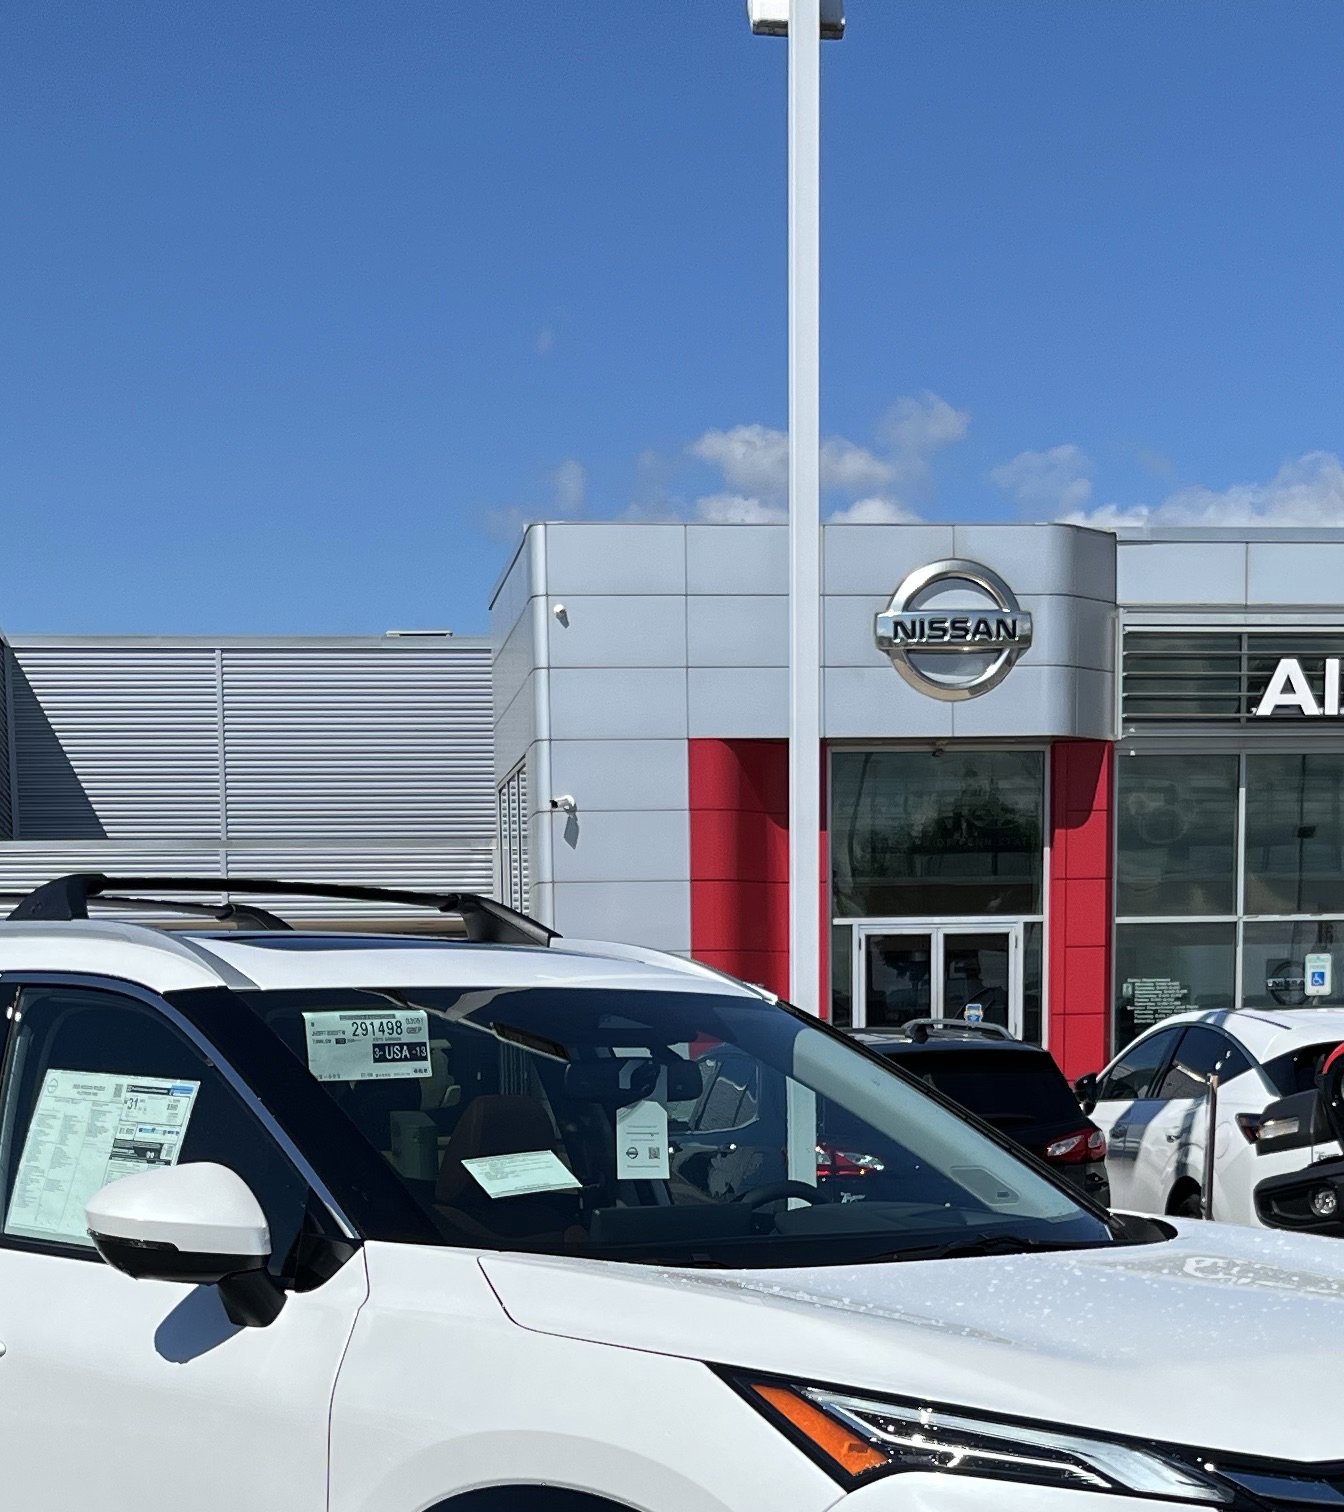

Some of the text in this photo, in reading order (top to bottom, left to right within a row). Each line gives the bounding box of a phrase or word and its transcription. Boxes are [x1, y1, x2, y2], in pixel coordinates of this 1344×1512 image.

[893, 618, 1018, 642] NISSAN
[351, 1020, 403, 1037] 291498
[385, 1045, 410, 1059] USA
[127, 1098, 138, 1110] 31
